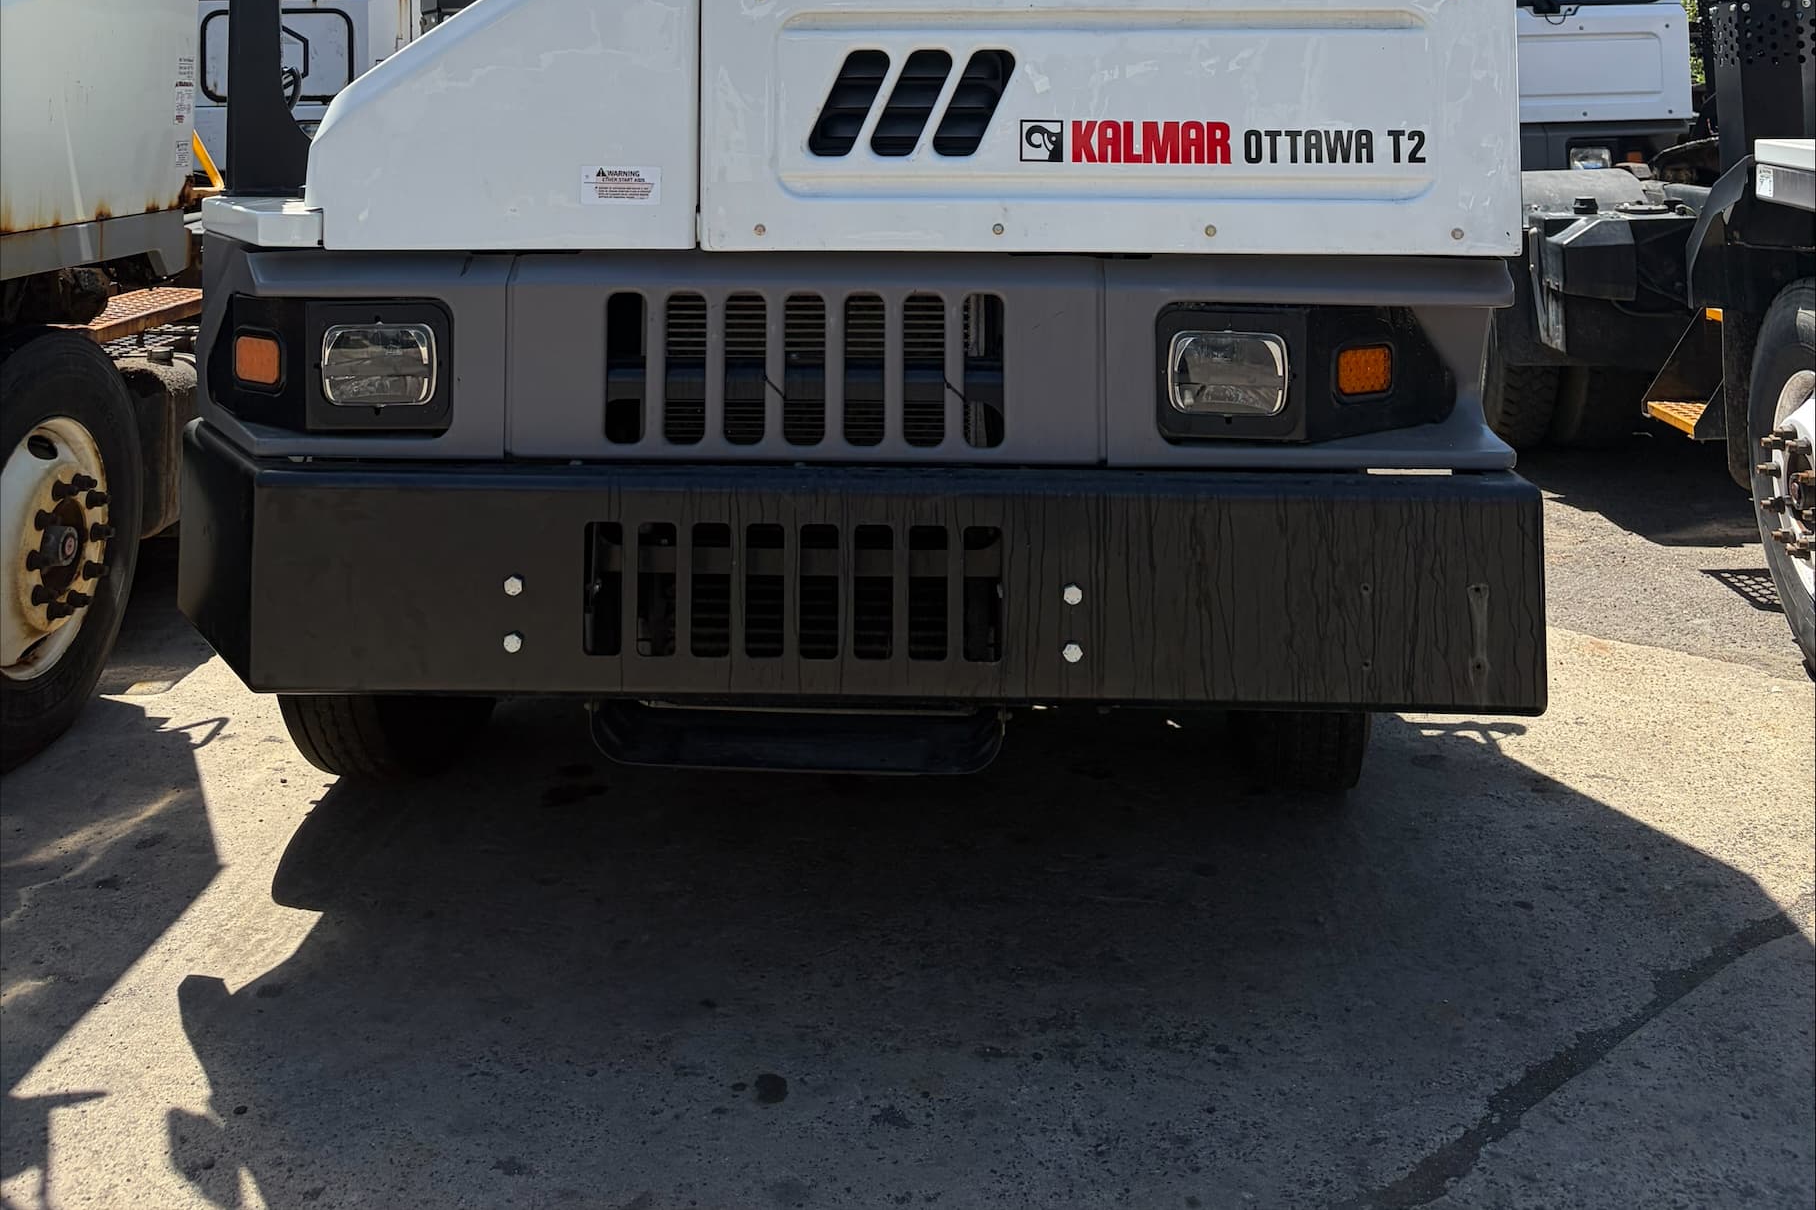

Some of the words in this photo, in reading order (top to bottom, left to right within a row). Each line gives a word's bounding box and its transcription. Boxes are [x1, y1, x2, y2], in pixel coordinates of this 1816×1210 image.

[1072, 121, 1232, 164] KALMAR
[1244, 130, 1374, 164] OTTAWA
[1387, 130, 1426, 163] T2
